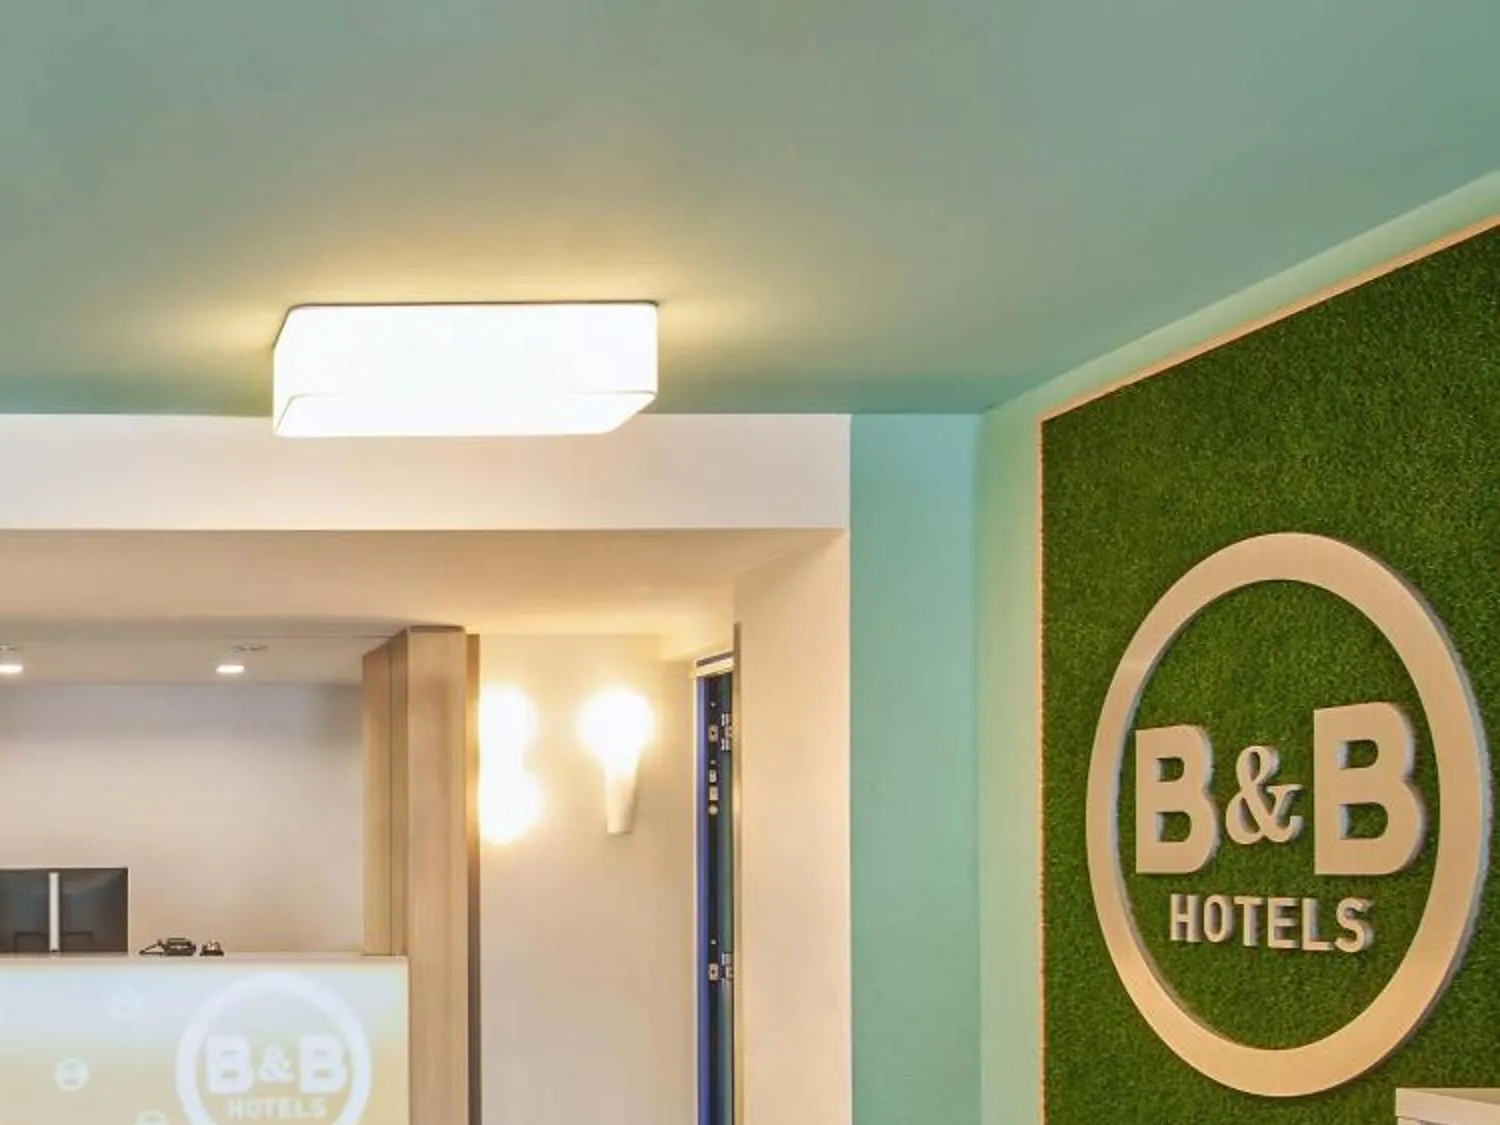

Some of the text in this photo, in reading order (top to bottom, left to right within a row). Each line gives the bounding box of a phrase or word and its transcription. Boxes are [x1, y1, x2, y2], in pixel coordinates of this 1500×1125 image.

[1136, 701, 1426, 875] B&B
[1169, 893, 1374, 954] HOTELS
[206, 1034, 348, 1095] B&B
[227, 1097, 327, 1119] HOTELS
